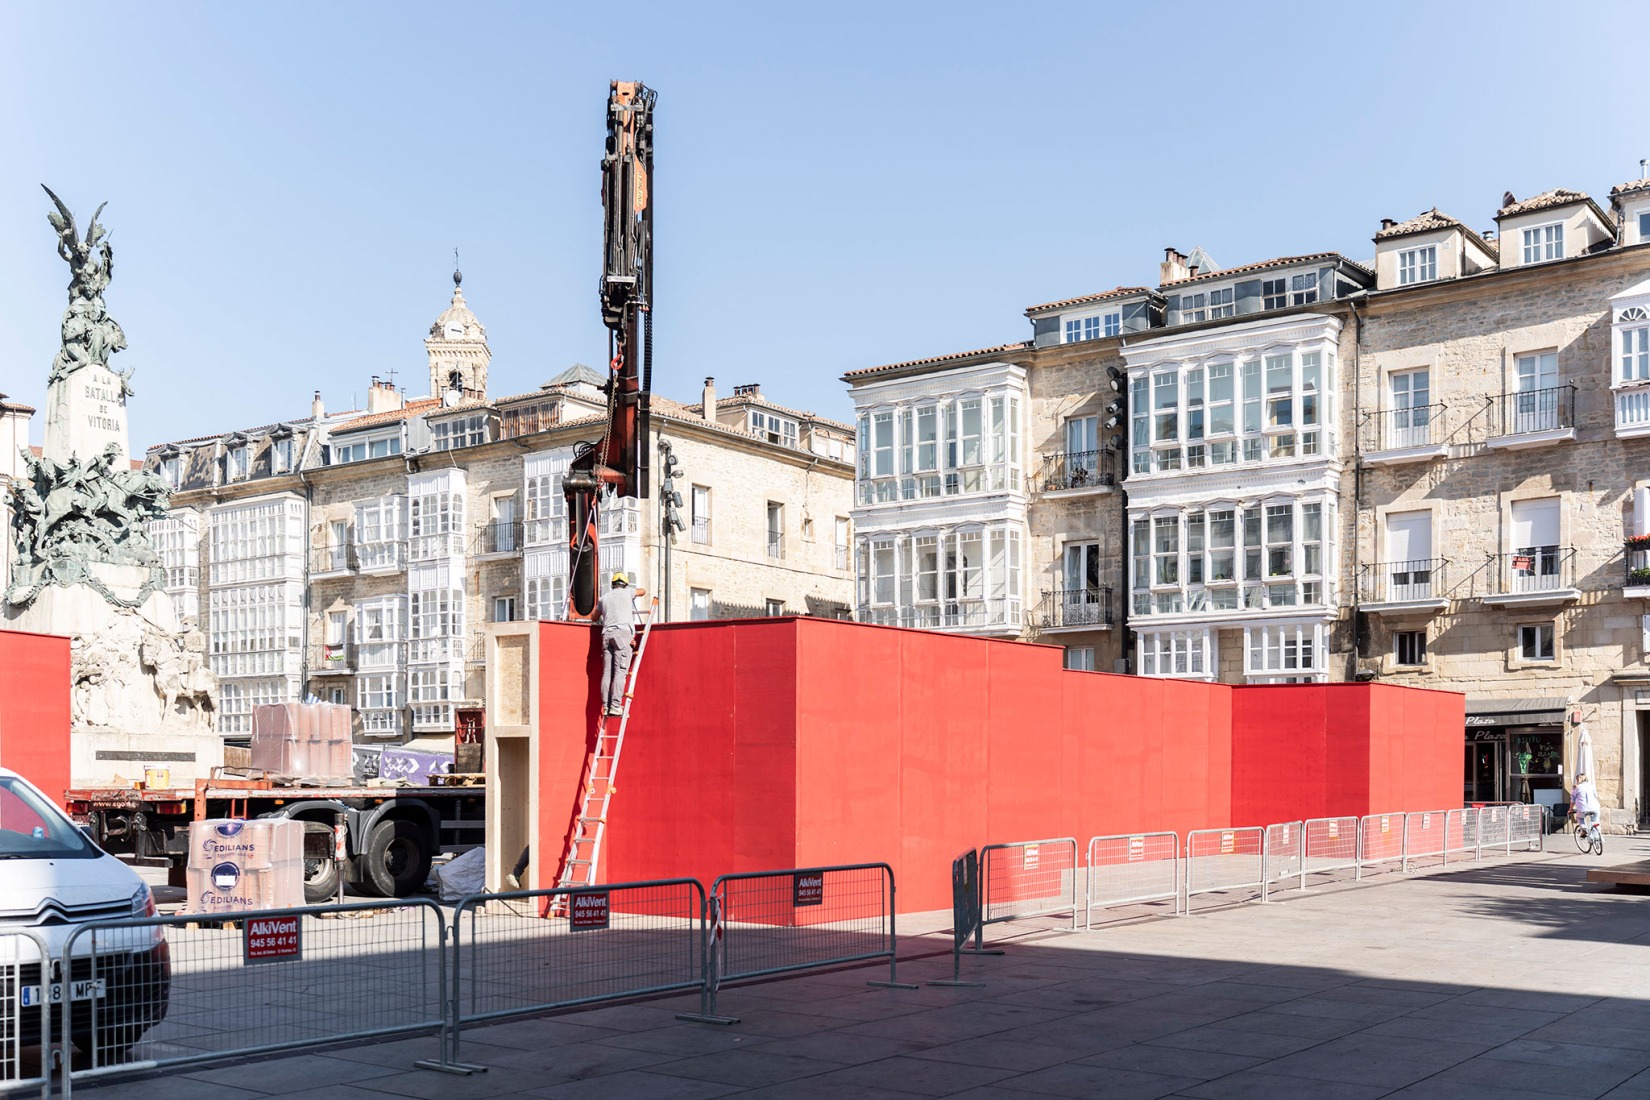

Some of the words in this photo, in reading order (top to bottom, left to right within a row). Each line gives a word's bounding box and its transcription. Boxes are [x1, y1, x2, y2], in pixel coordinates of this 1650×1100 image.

[93, 374, 97, 382] A
[102, 377, 111, 385] LA
[100, 405, 107, 414] DE
[87, 415, 121, 432] VITORIA
[1465, 716, 1496, 725] Plaza
[1474, 730, 1507, 741] Plaza
[213, 844, 255, 853] EDILIANS
[799, 877, 821, 887] AlkiVent
[210, 895, 253, 906] EDILIANS
[575, 896, 606, 907] AlkiVent
[575, 910, 585, 918] 945
[593, 909, 599, 917] 41
[250, 920, 297, 936] AlkiVent
[250, 938, 265, 949] 945
[266, 937, 276, 947] 56
[277, 936, 287, 945] 41
[288, 936, 297, 944] 41
